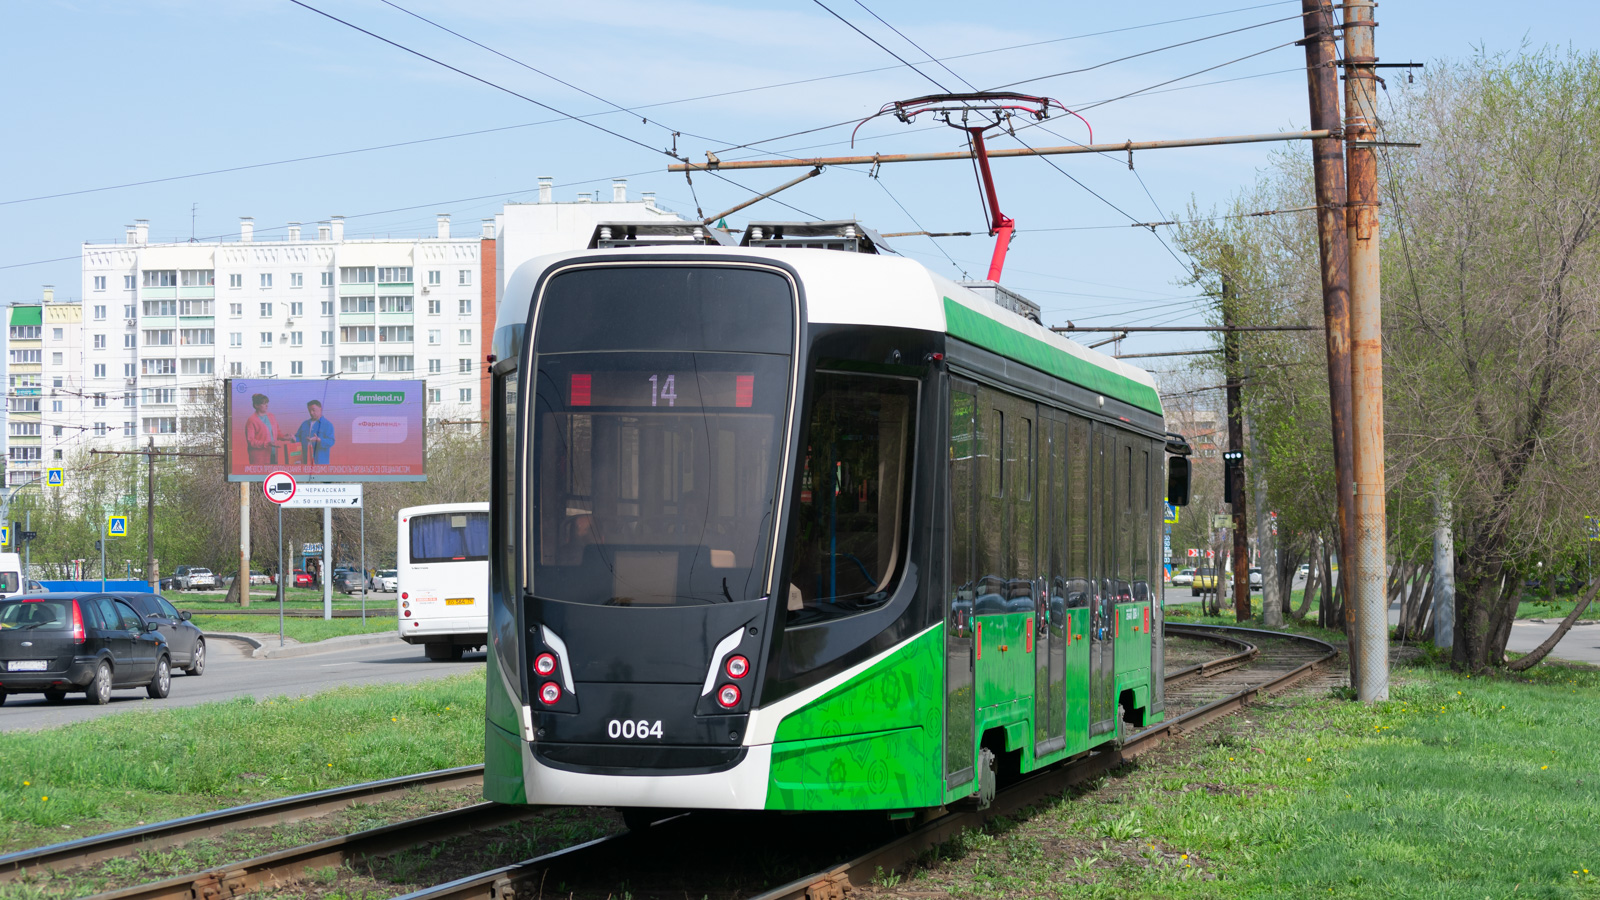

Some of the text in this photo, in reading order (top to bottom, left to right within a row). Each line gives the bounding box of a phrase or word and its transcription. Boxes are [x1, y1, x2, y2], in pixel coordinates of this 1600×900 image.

[356, 393, 403, 402] farmlend.ru
[648, 374, 677, 407] 14
[607, 719, 664, 740] 0064
